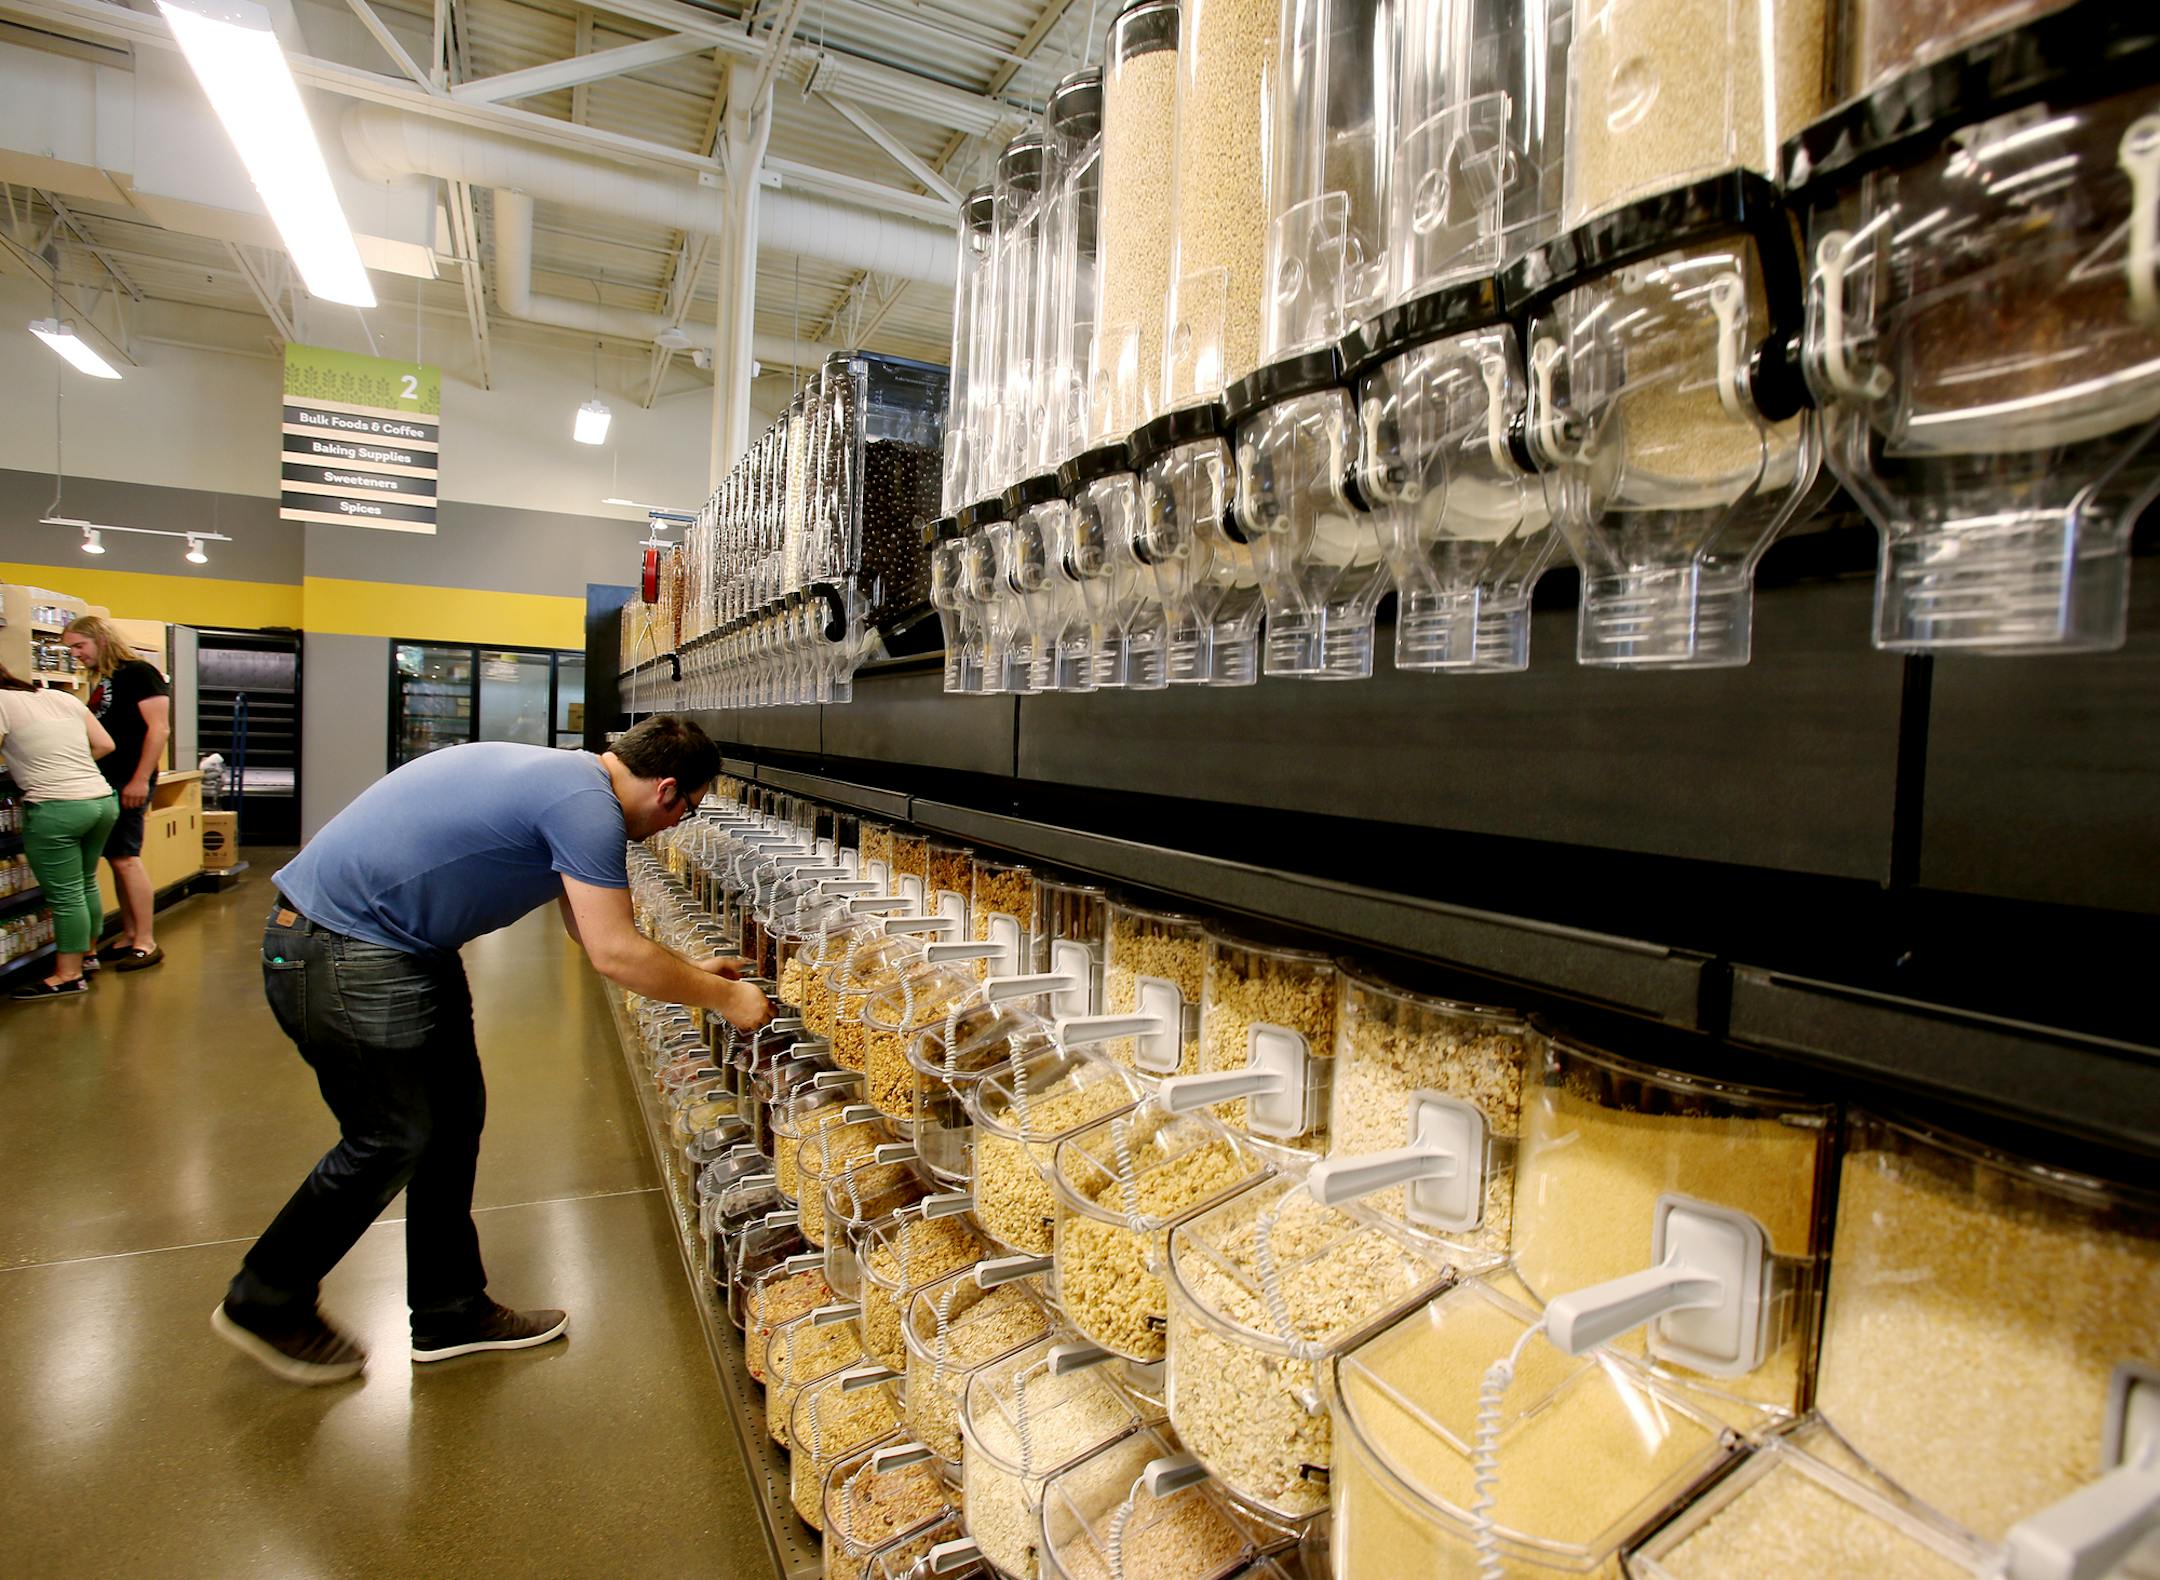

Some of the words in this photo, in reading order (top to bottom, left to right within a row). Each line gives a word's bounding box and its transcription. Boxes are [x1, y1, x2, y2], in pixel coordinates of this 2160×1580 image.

[400, 375, 418, 400] 2
[300, 412, 329, 426] Bulk
[332, 417, 369, 431] Foods
[371, 422, 380, 431] &
[383, 424, 425, 438] Coffee
[313, 442, 356, 459] Baking
[359, 448, 412, 463] Supplies
[324, 472, 398, 490] Sweeteners
[340, 502, 382, 515] Spices
